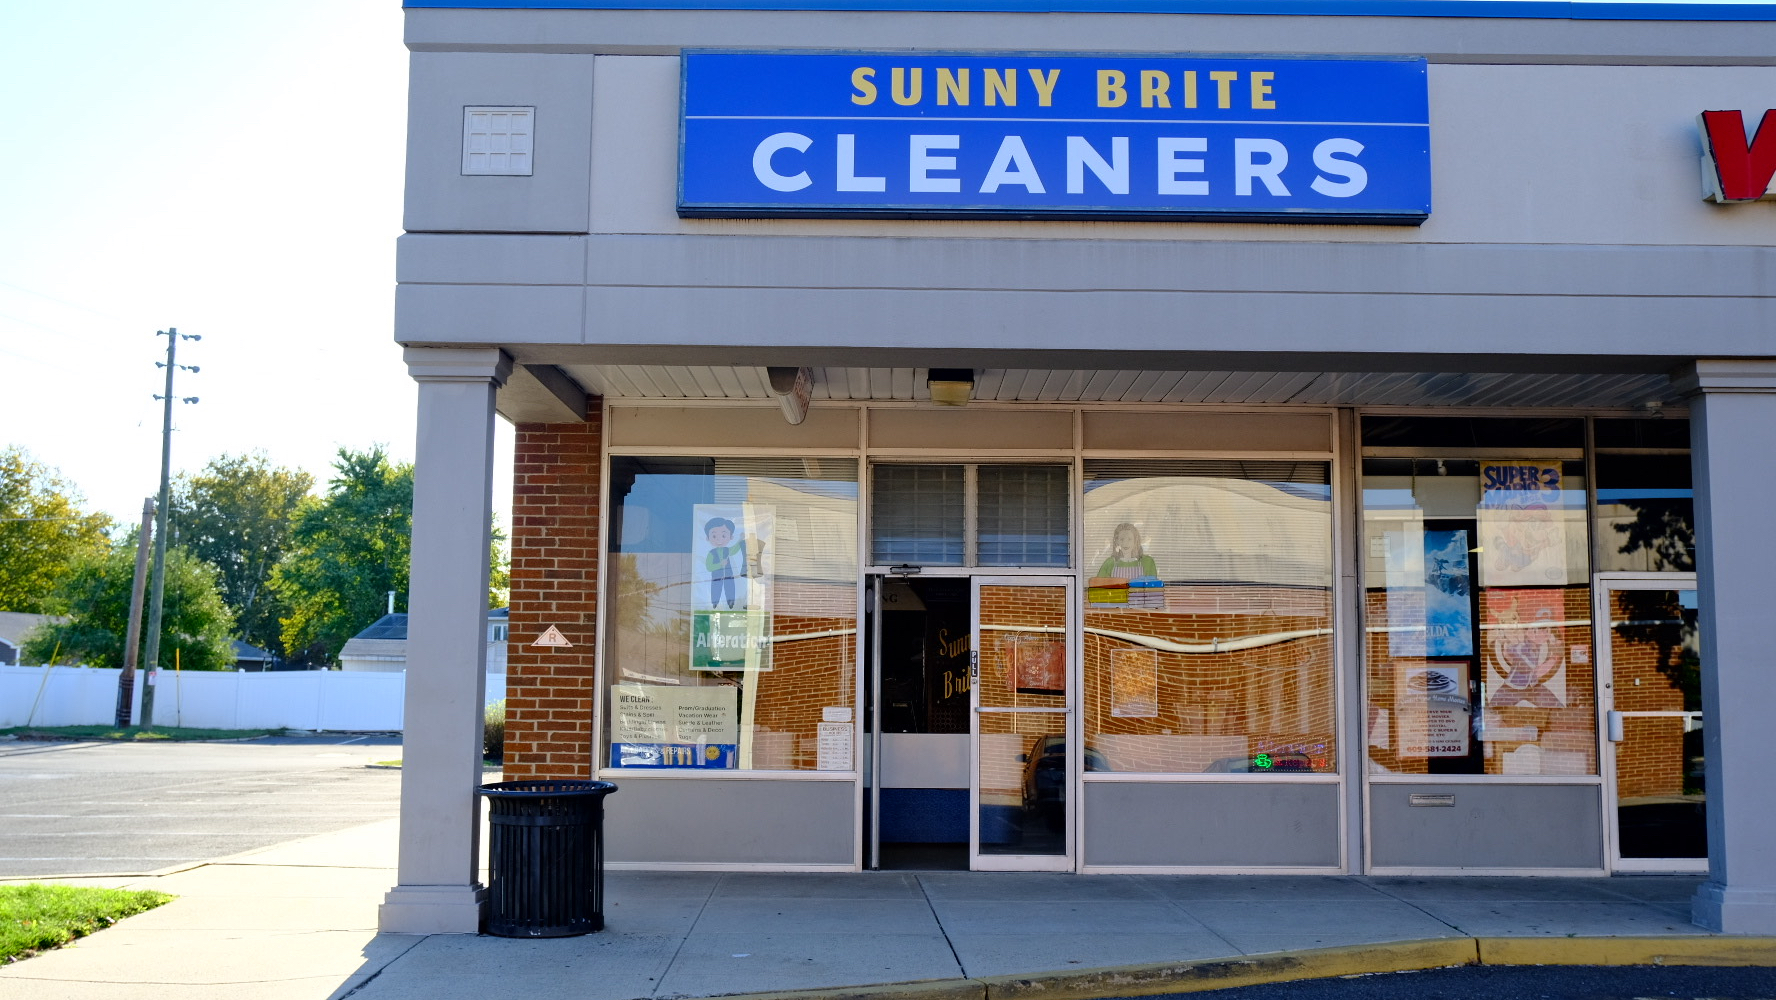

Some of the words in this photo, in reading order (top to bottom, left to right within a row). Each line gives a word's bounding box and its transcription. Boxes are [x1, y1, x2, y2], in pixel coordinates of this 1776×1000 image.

[850, 67, 1061, 108] SUNNY
[1097, 69, 1277, 111] BRITE
[752, 131, 1369, 198] CLEANERS
[1484, 466, 1540, 489] SUPER
[1541, 468, 1560, 503] 3
[1484, 481, 1541, 505] MARIO
[548, 633, 557, 643] R
[620, 695, 629, 703] WE
[666, 747, 691, 755] REPAIRS
[1406, 745, 1462, 753] 609-581-2424
